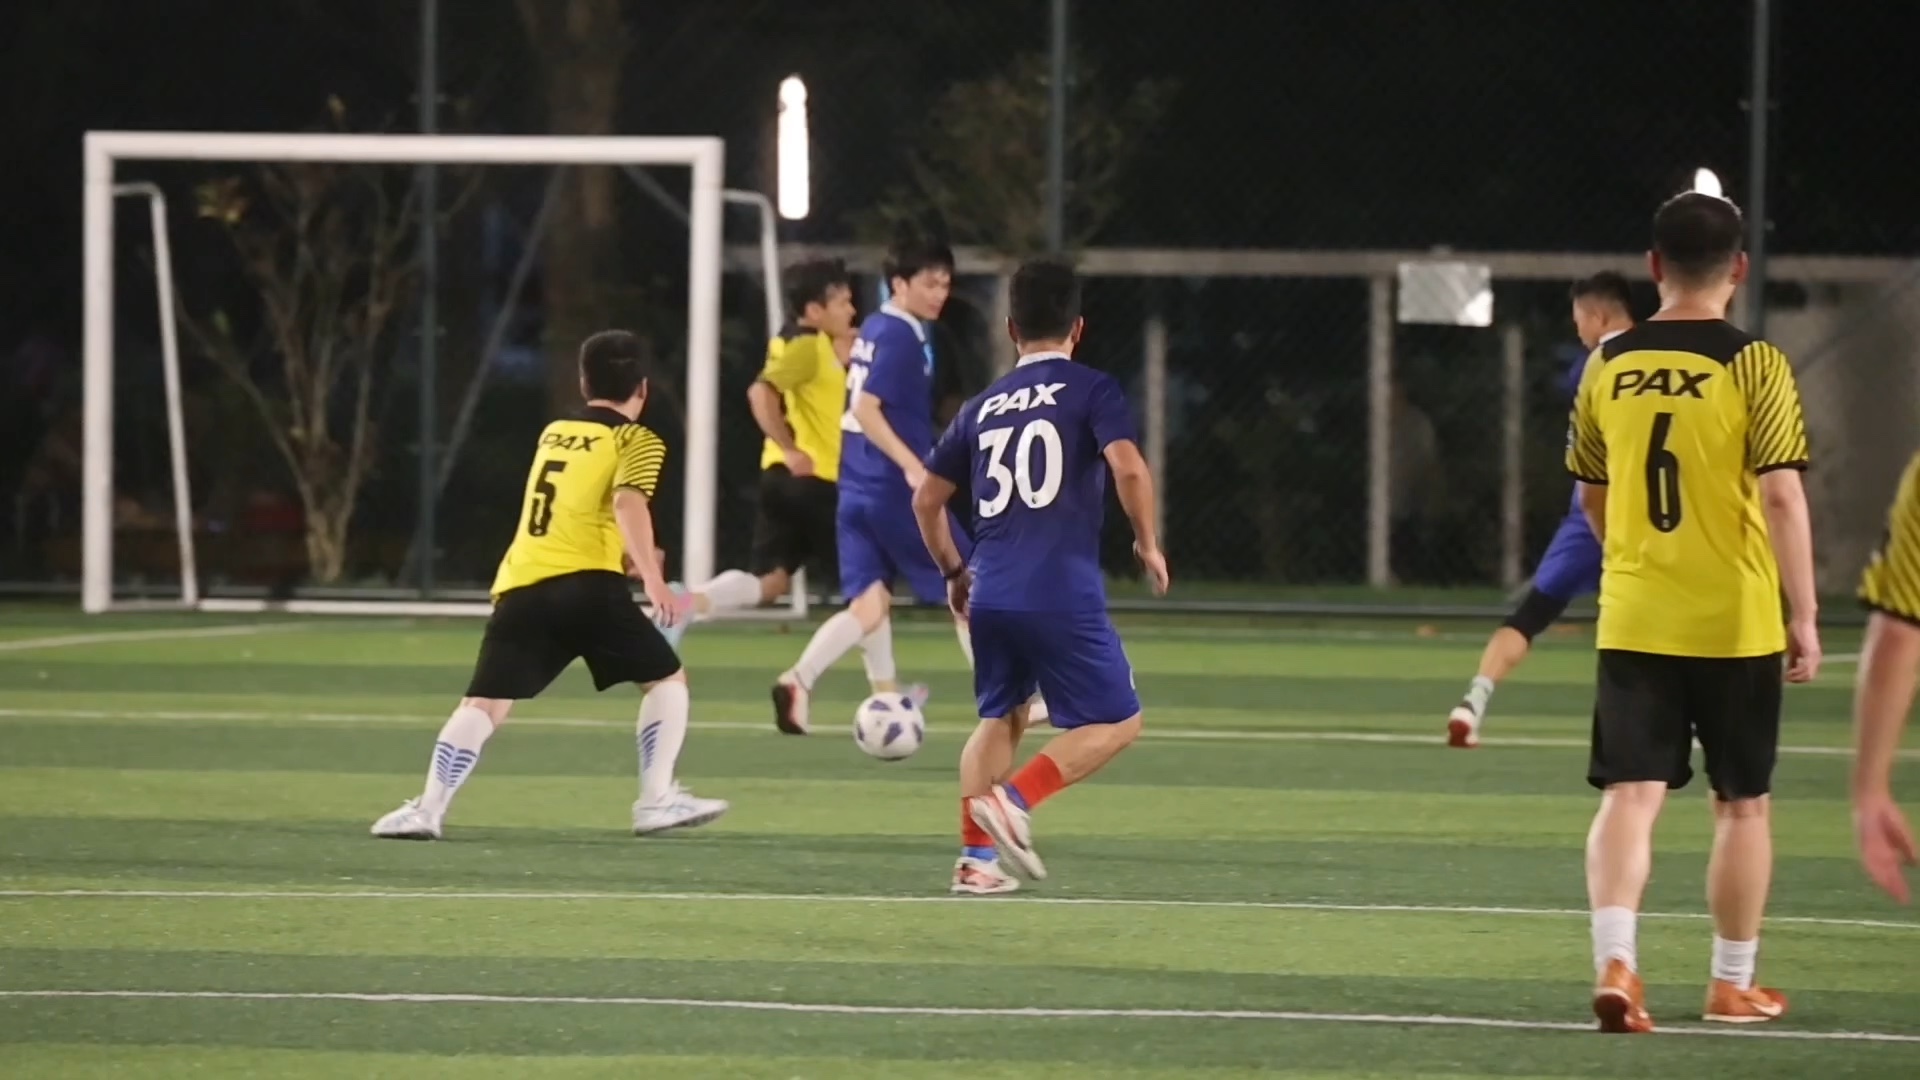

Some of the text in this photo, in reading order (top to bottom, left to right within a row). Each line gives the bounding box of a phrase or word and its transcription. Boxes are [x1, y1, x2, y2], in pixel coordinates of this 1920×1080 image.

[976, 382, 1067, 425] PAX
[1611, 367, 1713, 401] PAX
[543, 432, 604, 452] PAX
[977, 418, 1063, 518] 30
[1645, 411, 1682, 533] 6
[528, 460, 567, 537] 5
